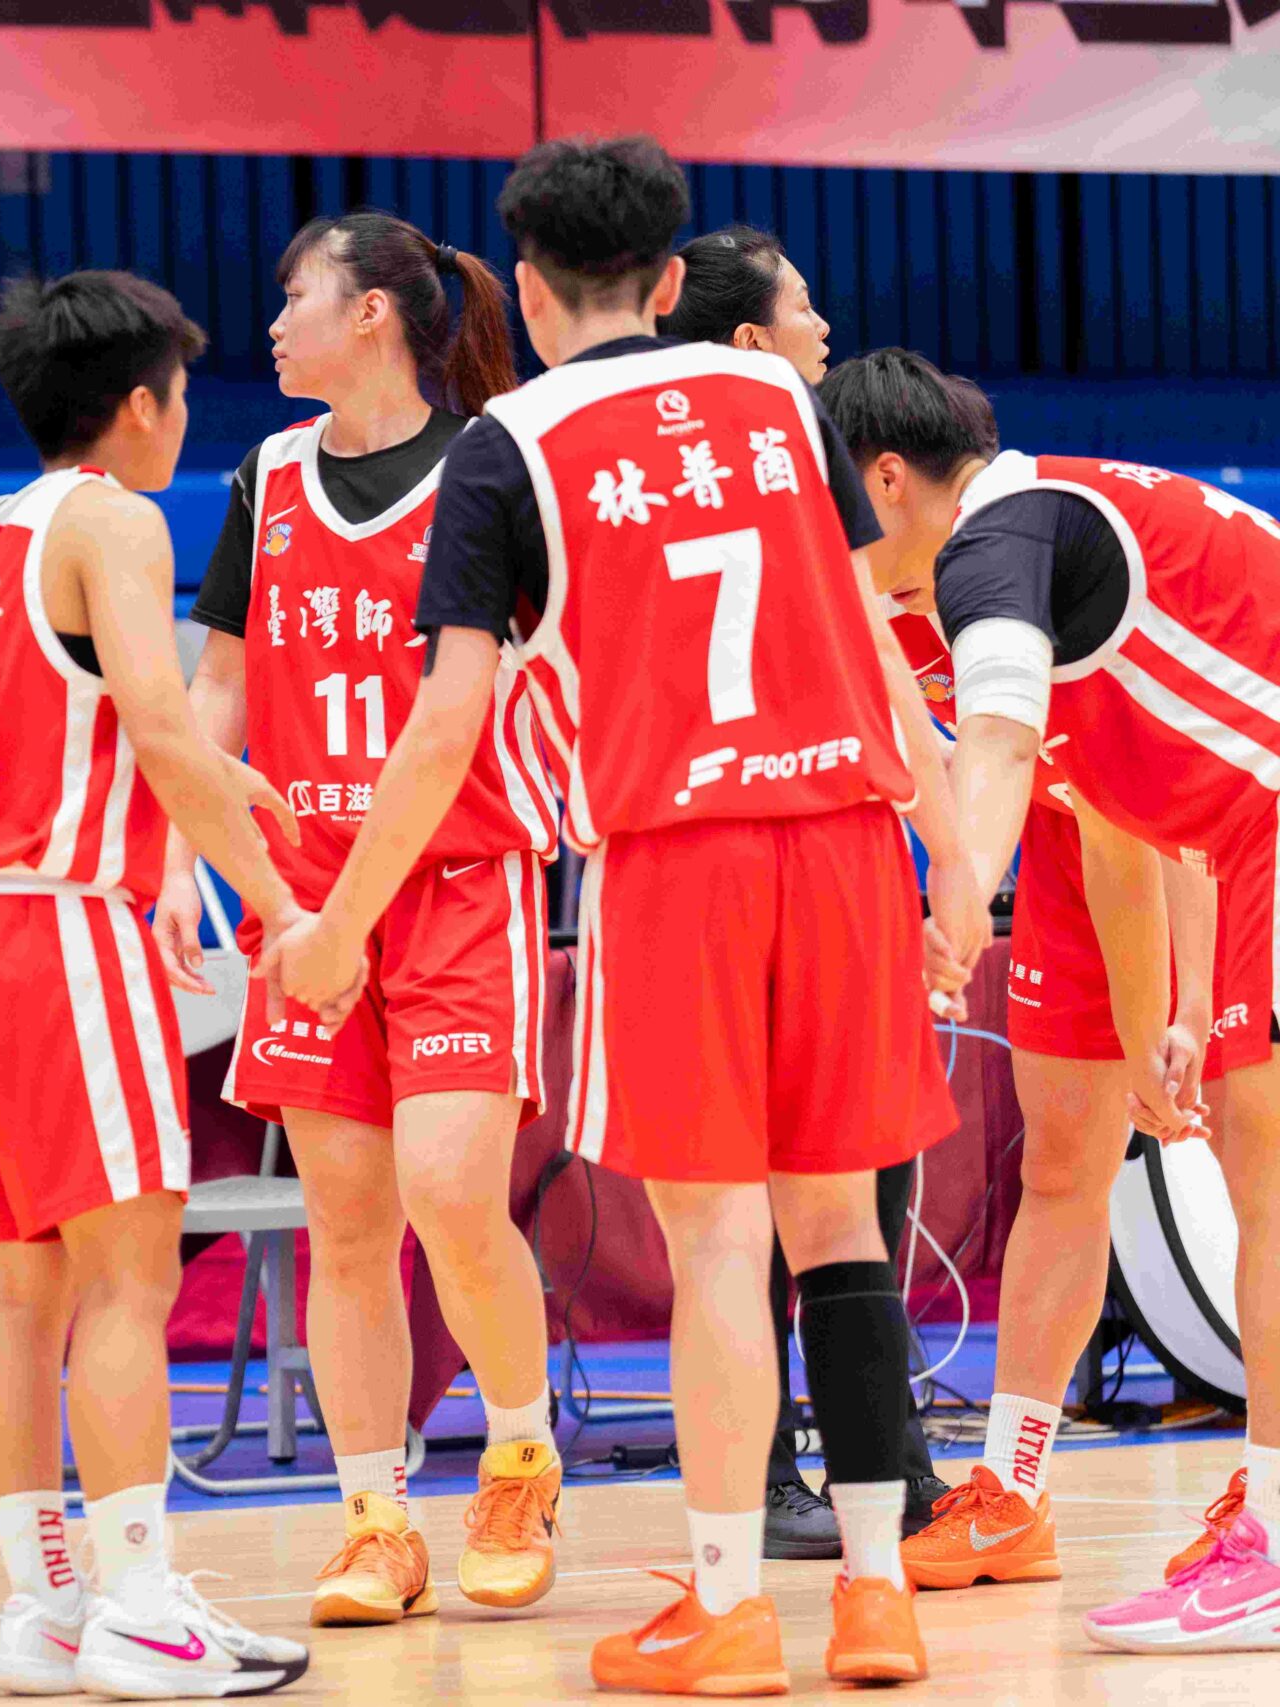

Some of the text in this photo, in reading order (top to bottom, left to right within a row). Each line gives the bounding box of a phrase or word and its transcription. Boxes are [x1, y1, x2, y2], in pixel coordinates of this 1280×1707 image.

[663, 526, 763, 725] 7
[314, 672, 387, 759] 11
[741, 736, 862, 786] FOOTER
[266, 1043, 333, 1065] Momentum
[412, 1032, 493, 1061] FOOTER
[1013, 1415, 1051, 1489] NTNU
